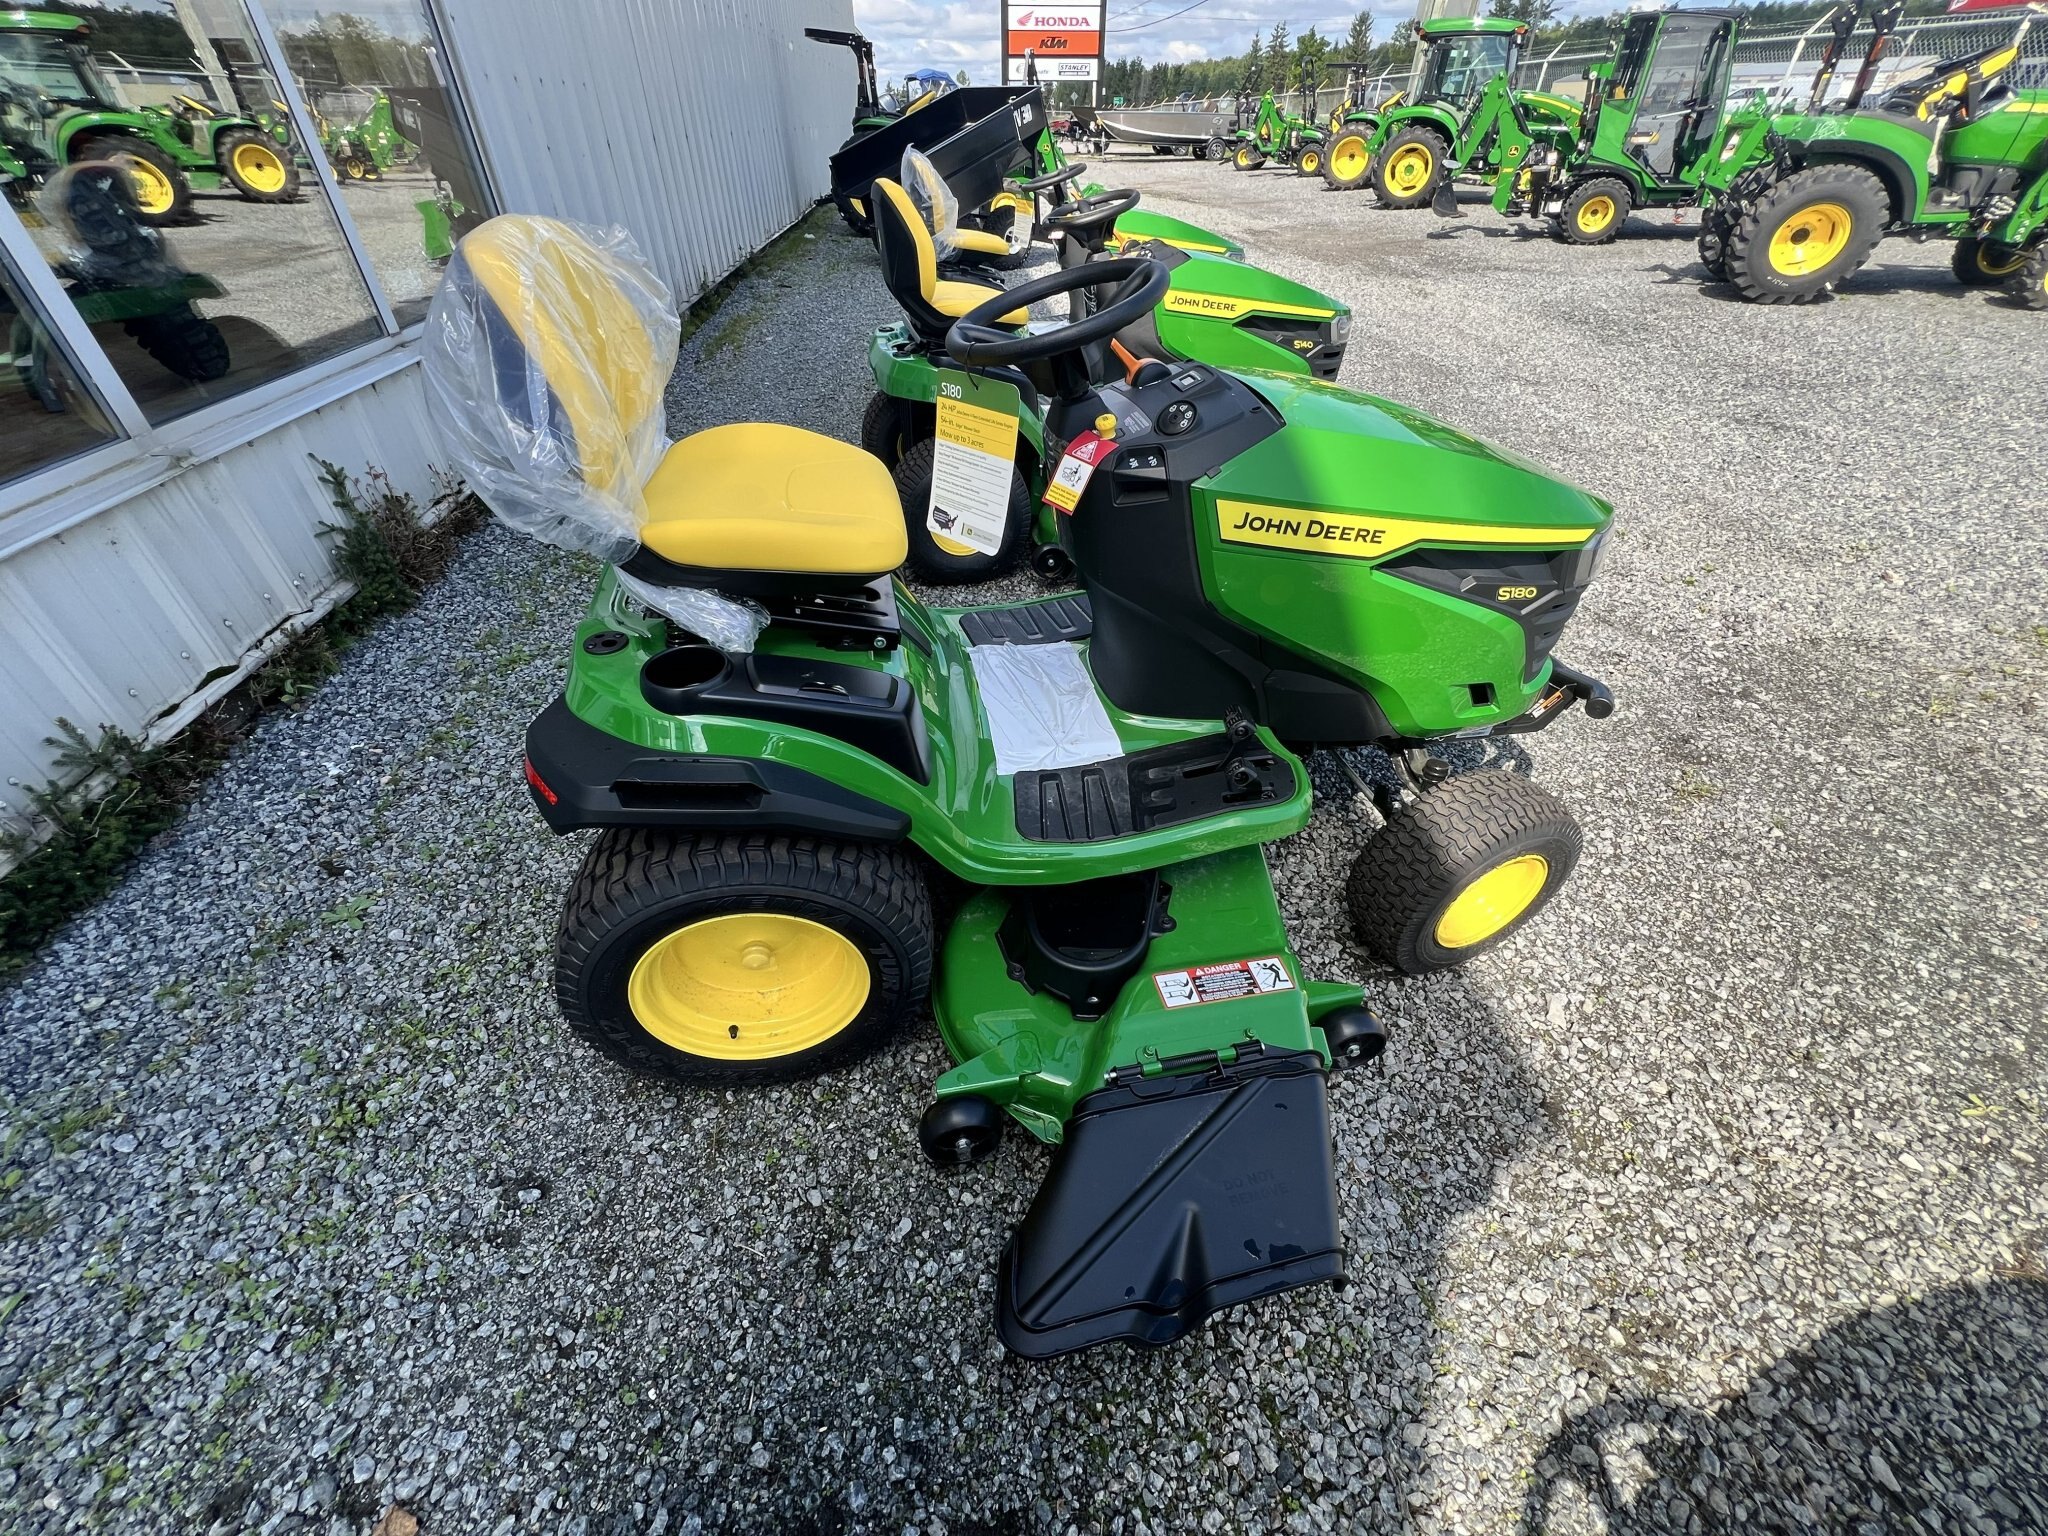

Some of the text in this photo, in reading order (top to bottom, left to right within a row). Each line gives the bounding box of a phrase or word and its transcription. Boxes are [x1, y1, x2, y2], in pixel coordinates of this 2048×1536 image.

[1034, 16, 1091, 27] HONDA
[1039, 36, 1068, 49] KTM
[1170, 295, 1237, 312] JOHN DEERE
[1293, 340, 1314, 350] S140
[941, 382, 962, 399] S180
[940, 429, 953, 439] Mow
[953, 434, 960, 442] up
[961, 435, 967, 443] to
[971, 440, 984, 449] acres
[1233, 511, 1387, 545] JOHN DEERE
[1496, 585, 1538, 602] S180
[1203, 962, 1242, 974] DANGER
